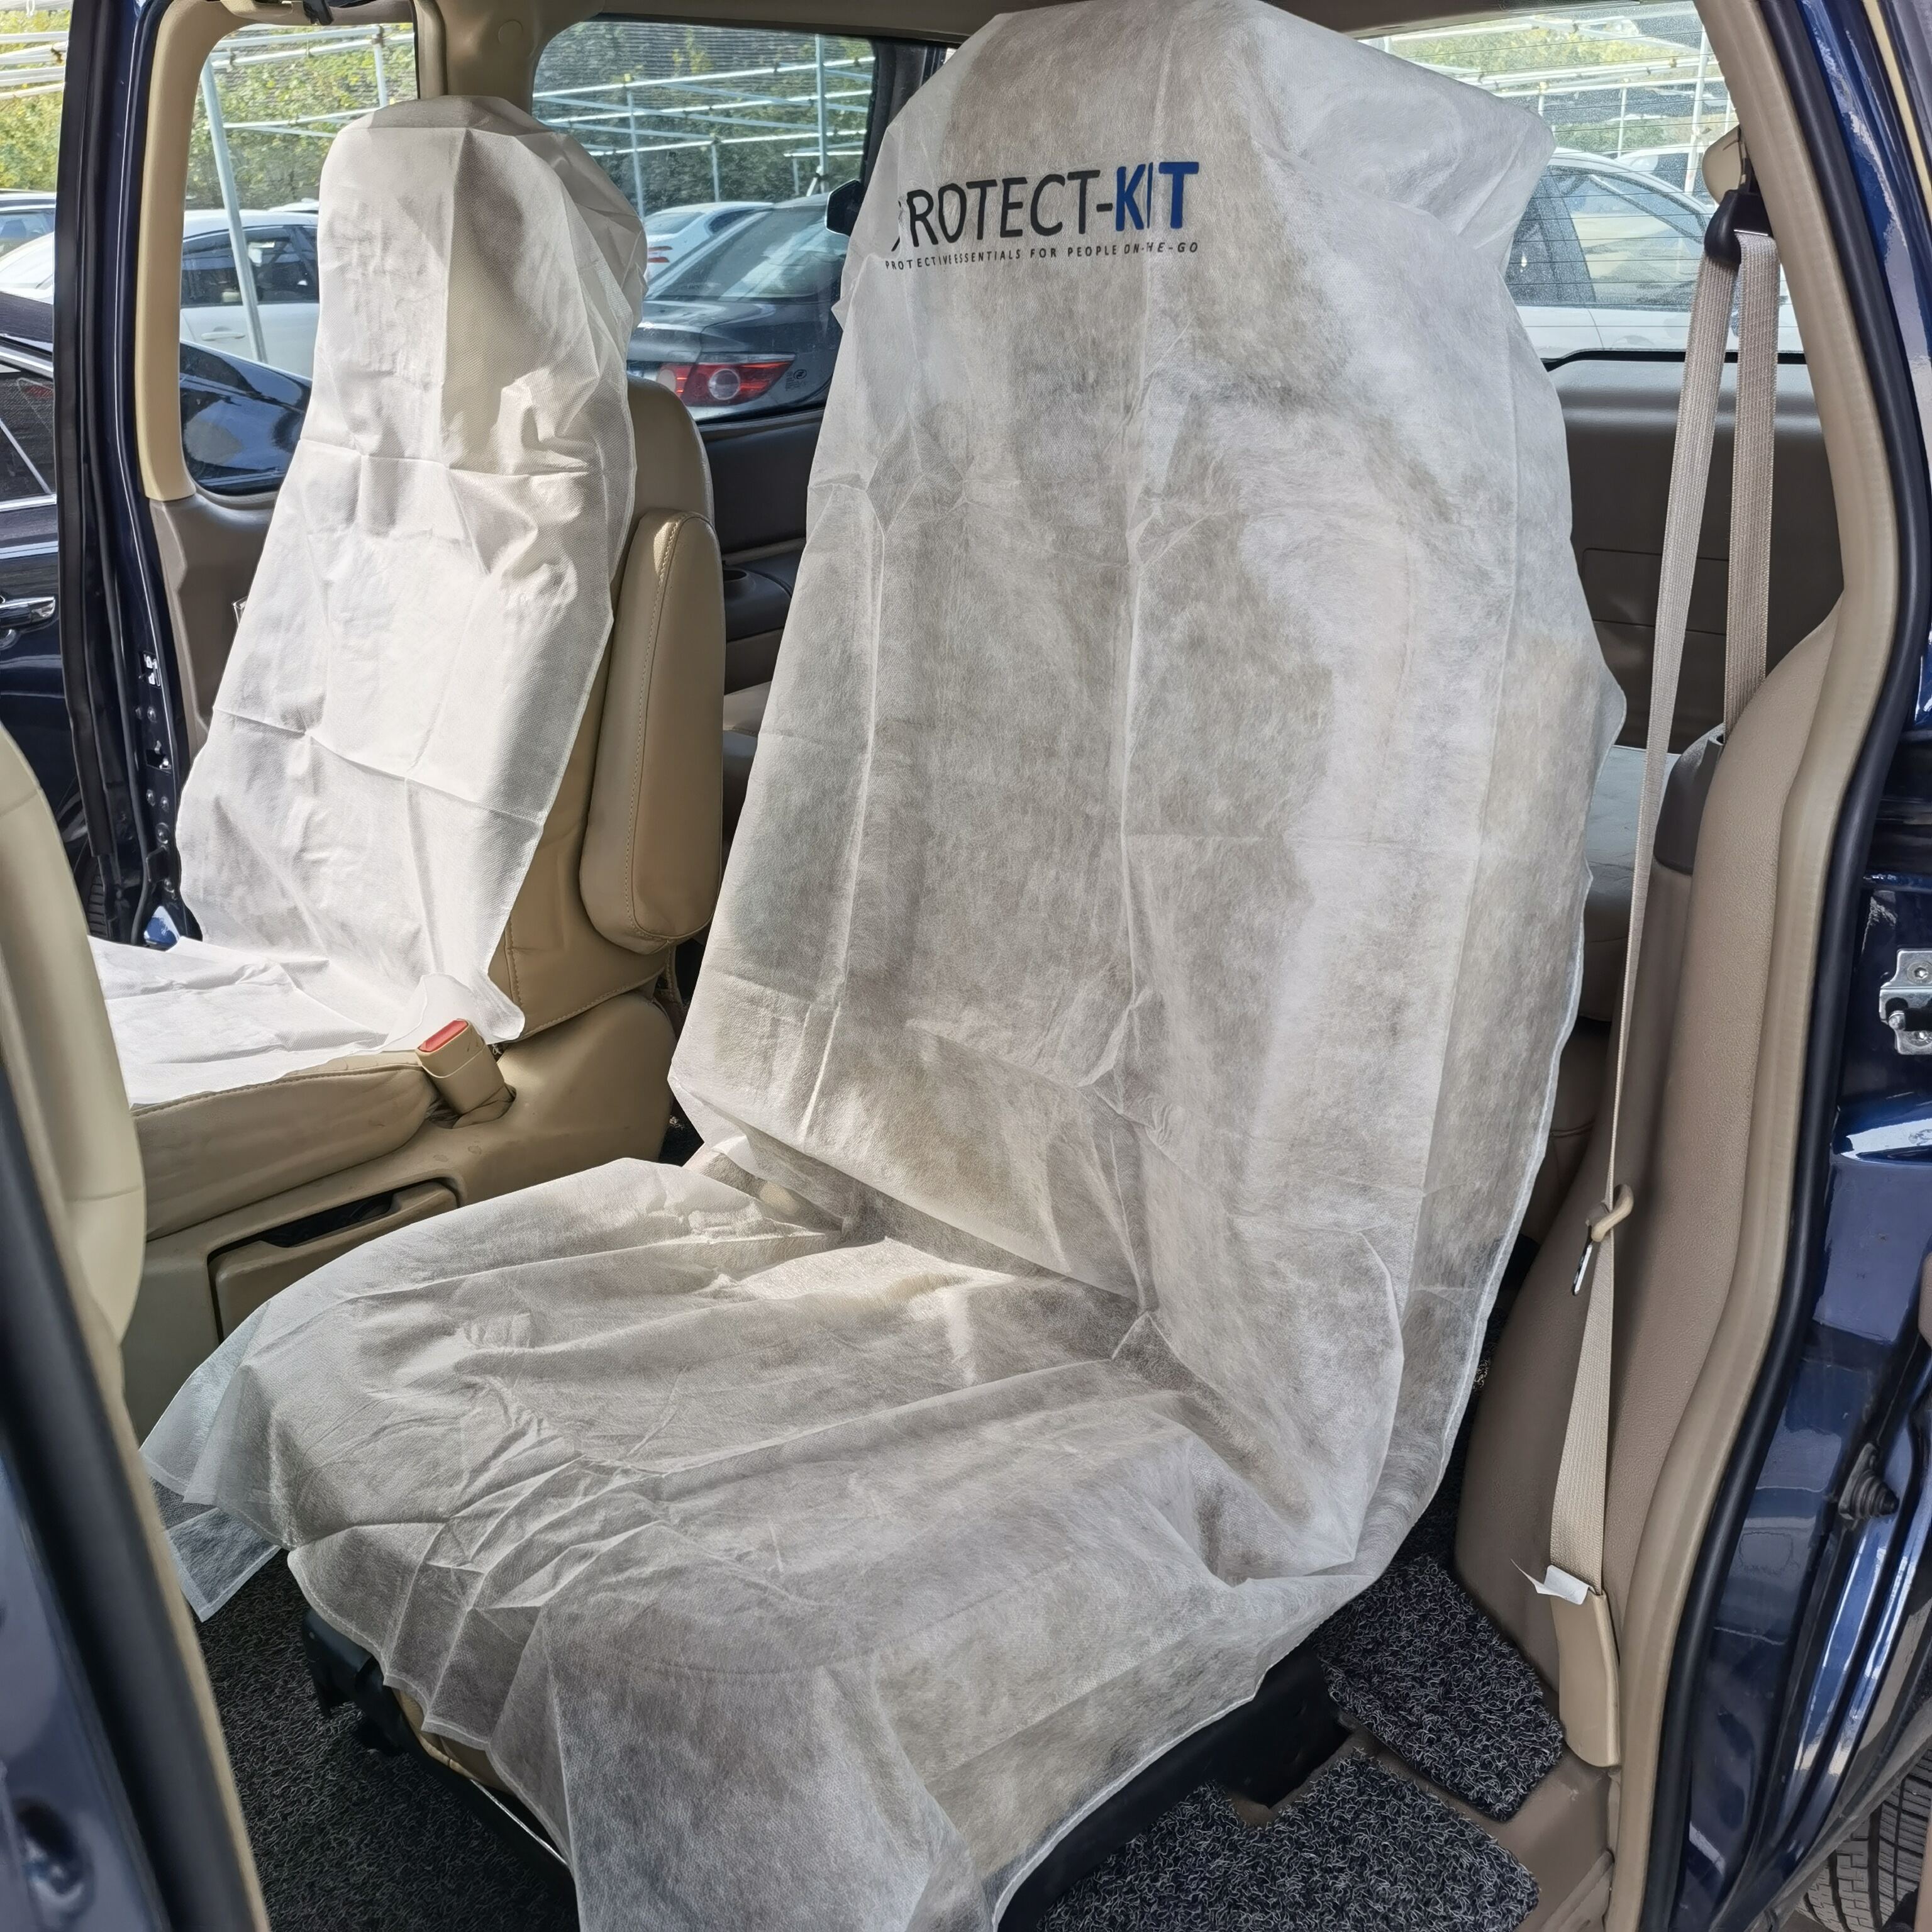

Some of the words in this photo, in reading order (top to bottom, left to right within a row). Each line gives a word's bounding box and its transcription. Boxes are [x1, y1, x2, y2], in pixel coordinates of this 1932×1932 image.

[891, 162, 1199, 252] ROTECT-KIT
[1030, 248, 1057, 258] FOR
[1068, 245, 1117, 257] PEOPLE
[1124, 242, 1199, 255] ON-HE-GO
